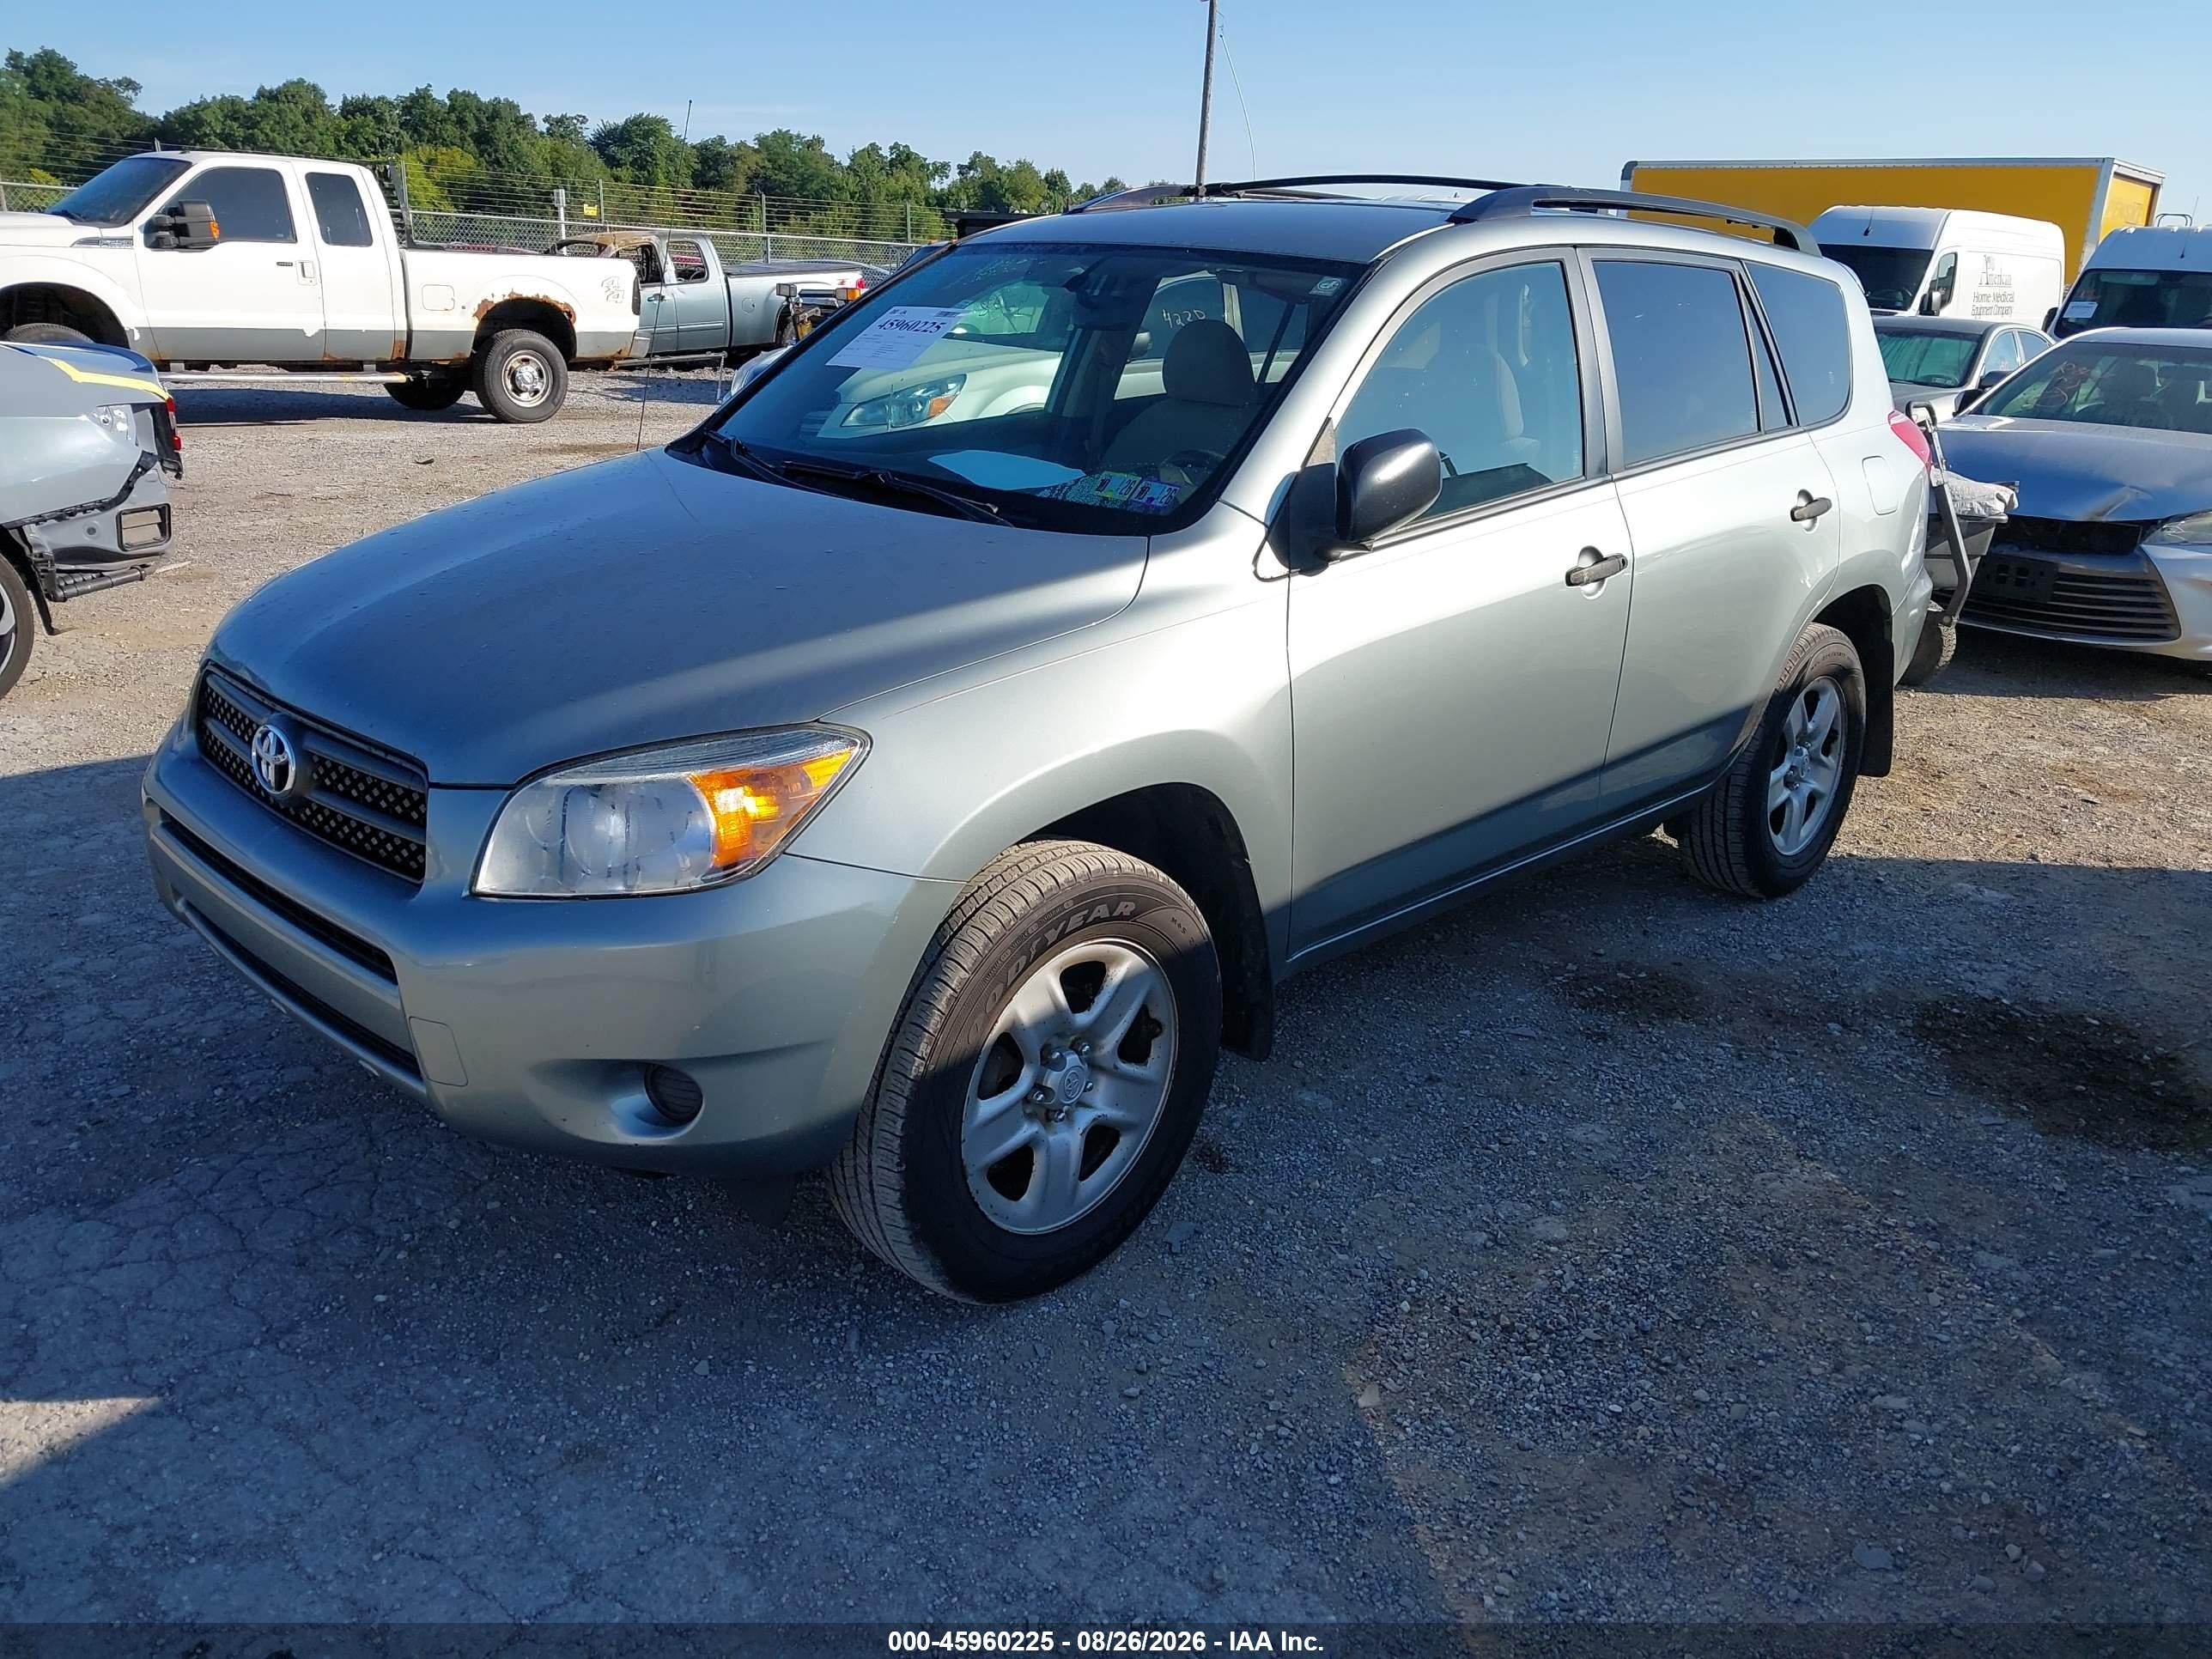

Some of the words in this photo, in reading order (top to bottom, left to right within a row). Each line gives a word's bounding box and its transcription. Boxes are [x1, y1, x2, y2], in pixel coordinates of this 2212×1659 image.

[1973, 292, 1991, 302] Home
[1992, 291, 2014, 302] Medical
[878, 319, 947, 333] 45960225
